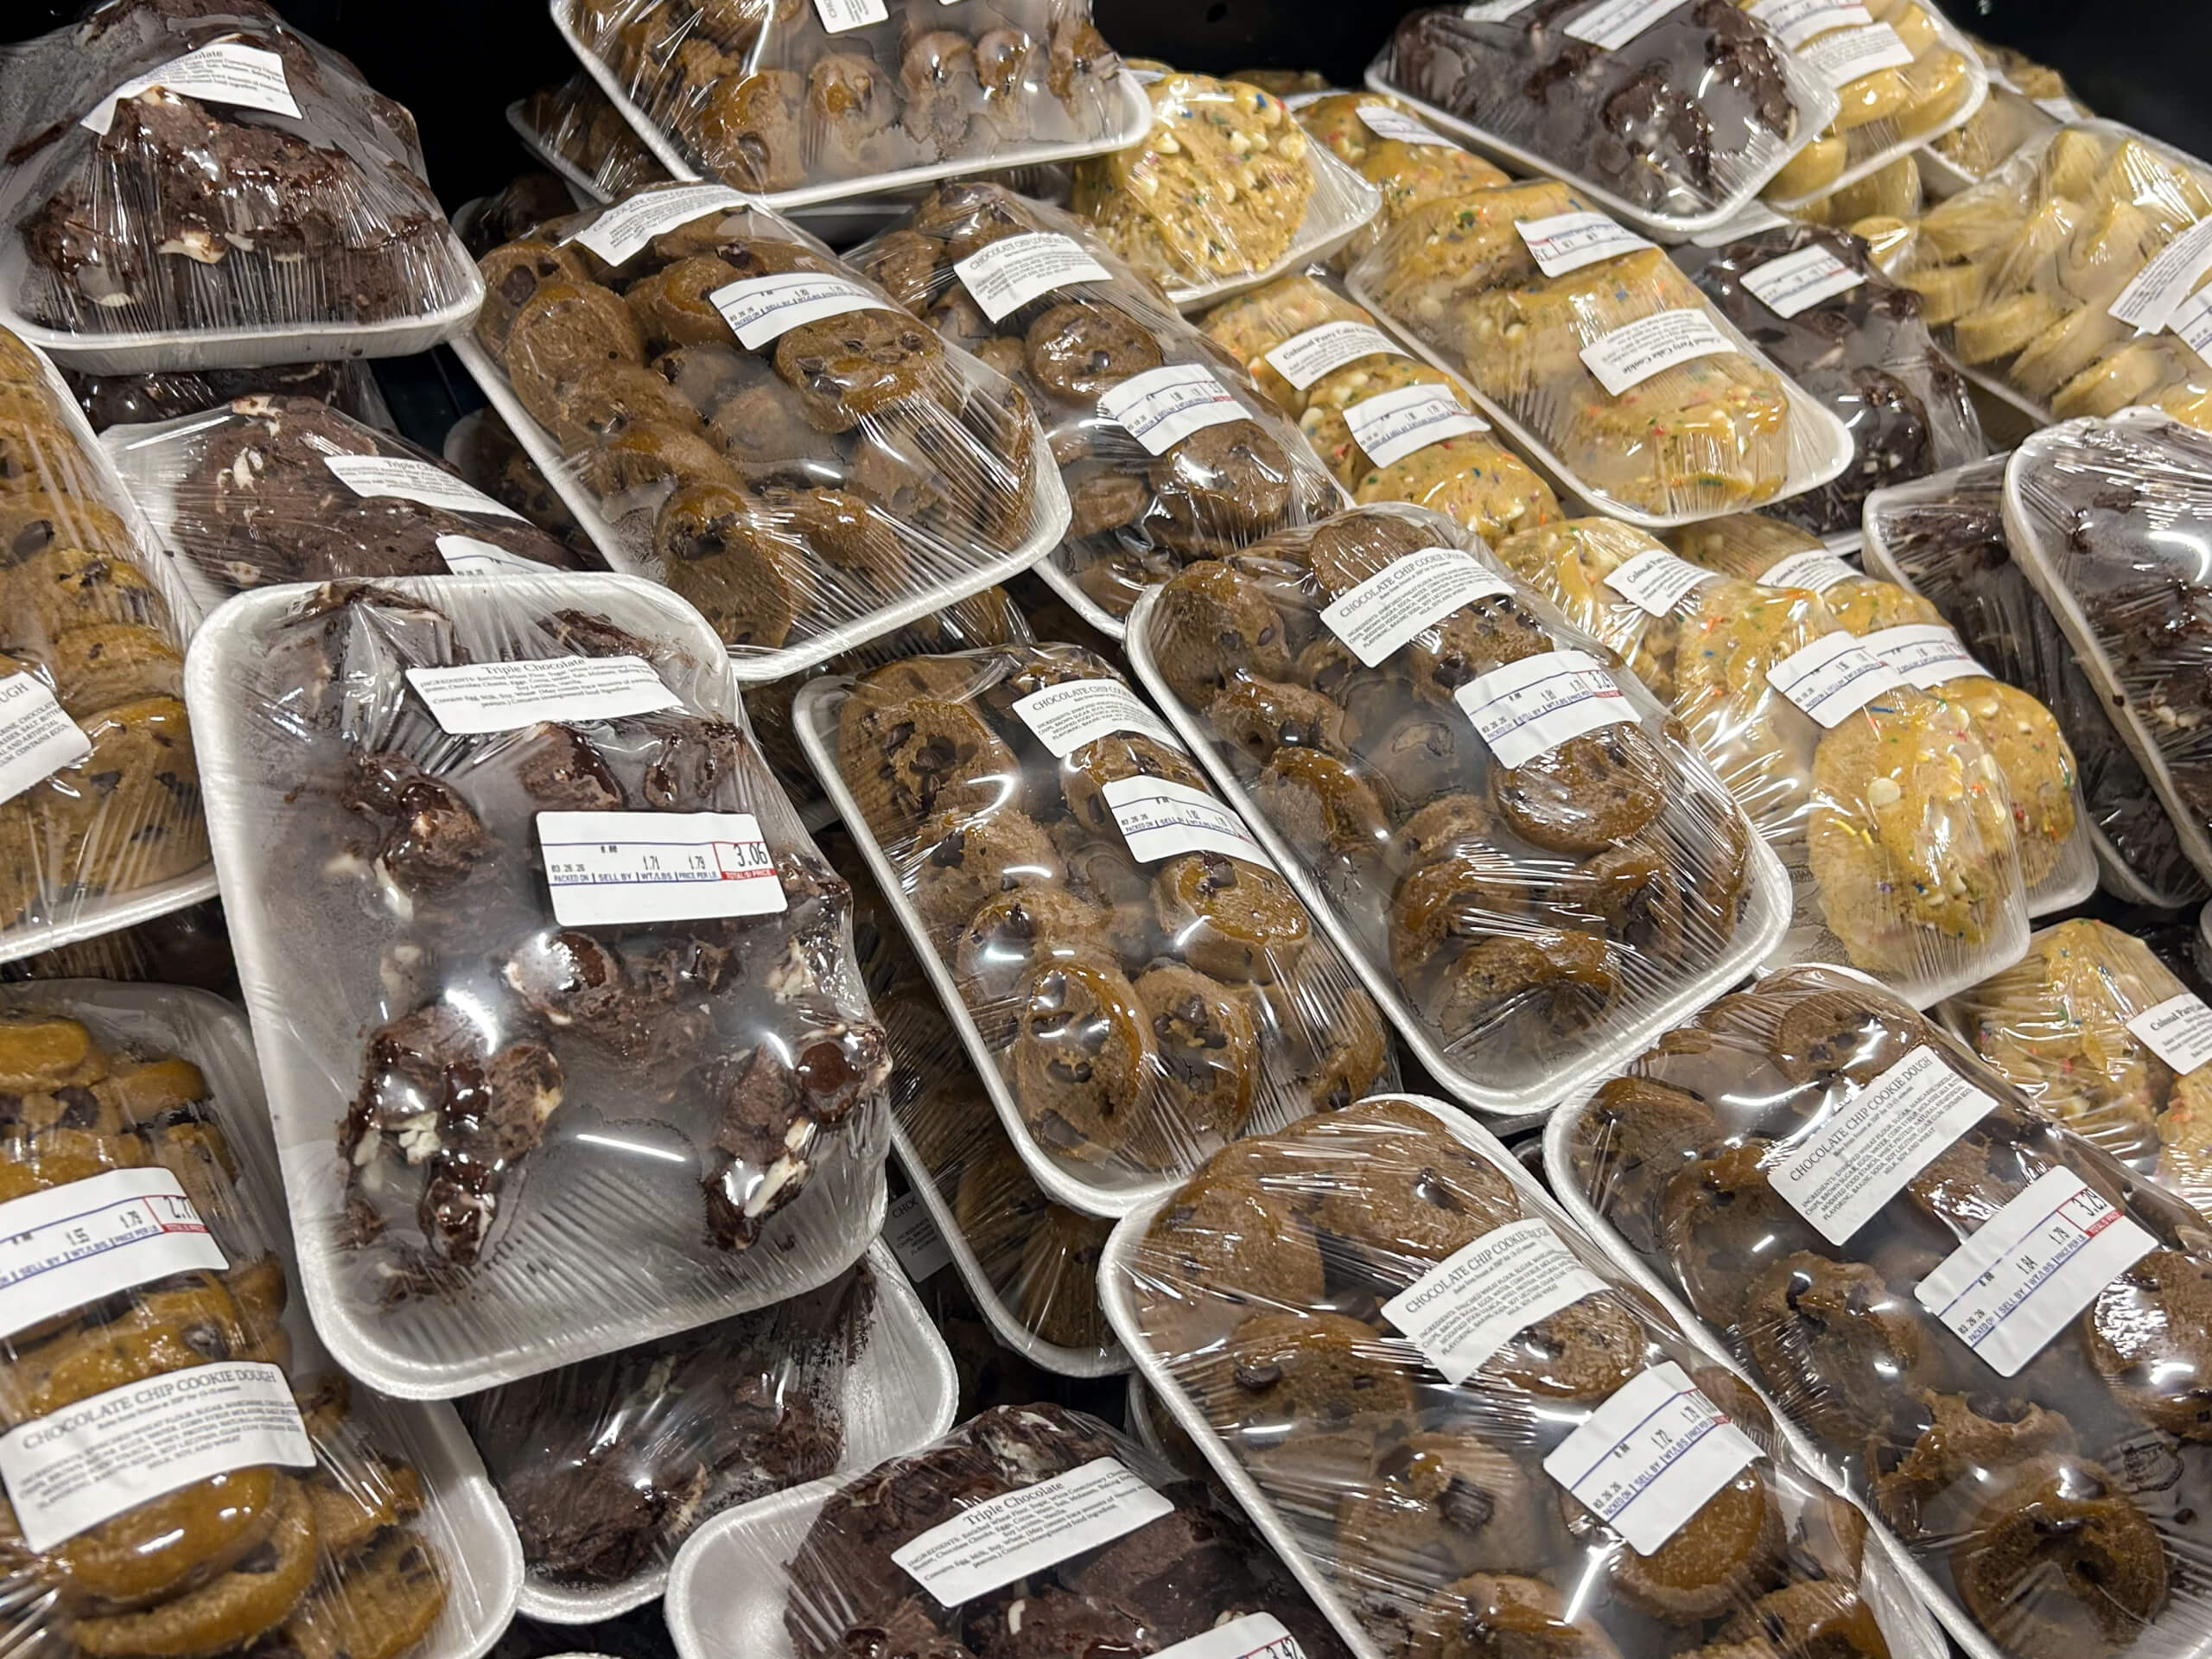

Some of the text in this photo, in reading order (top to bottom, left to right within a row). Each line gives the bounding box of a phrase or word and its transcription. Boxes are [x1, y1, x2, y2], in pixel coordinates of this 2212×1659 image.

[969, 242, 1015, 270] CHOCOLATE
[1340, 553, 1444, 618] CHOCOLATE CHIP COOKIE
[481, 658, 587, 677] Triple Chocolate
[0, 683, 29, 702] UGH
[1033, 688, 1088, 711] CHOCOLATE
[733, 843, 769, 867] 3.06
[580, 873, 589, 881] ON
[753, 868, 771, 878] PRICE
[1790, 1056, 1932, 1180] CHOCOLATE CHIP COOKIE DOUGH
[2071, 1187, 2107, 1216] 3.29
[2049, 1227, 2069, 1244] 1.79
[20, 1262, 44, 1276] SELL
[46, 1256, 60, 1269] BY
[1406, 1230, 1529, 1313] CHOCOLATE CHIP COOKIE
[1968, 1323, 1988, 1341] PACKED
[1999, 1298, 2016, 1313] SELL
[2013, 1287, 2025, 1299] BY
[2055, 1247, 2070, 1261] PRICE
[2067, 1239, 2079, 1249] PER
[22, 1370, 277, 1450] CHOCOLATE CHIP COOKIE DOUGH
[1651, 1429, 1672, 1449] 1.72
[1603, 1497, 1625, 1515] PACKED
[1621, 1491, 1633, 1499] ON
[1634, 1471, 1654, 1486] SELL
[1649, 1461, 1660, 1472] BY
[963, 1480, 1065, 1526] Triple Chocolate
